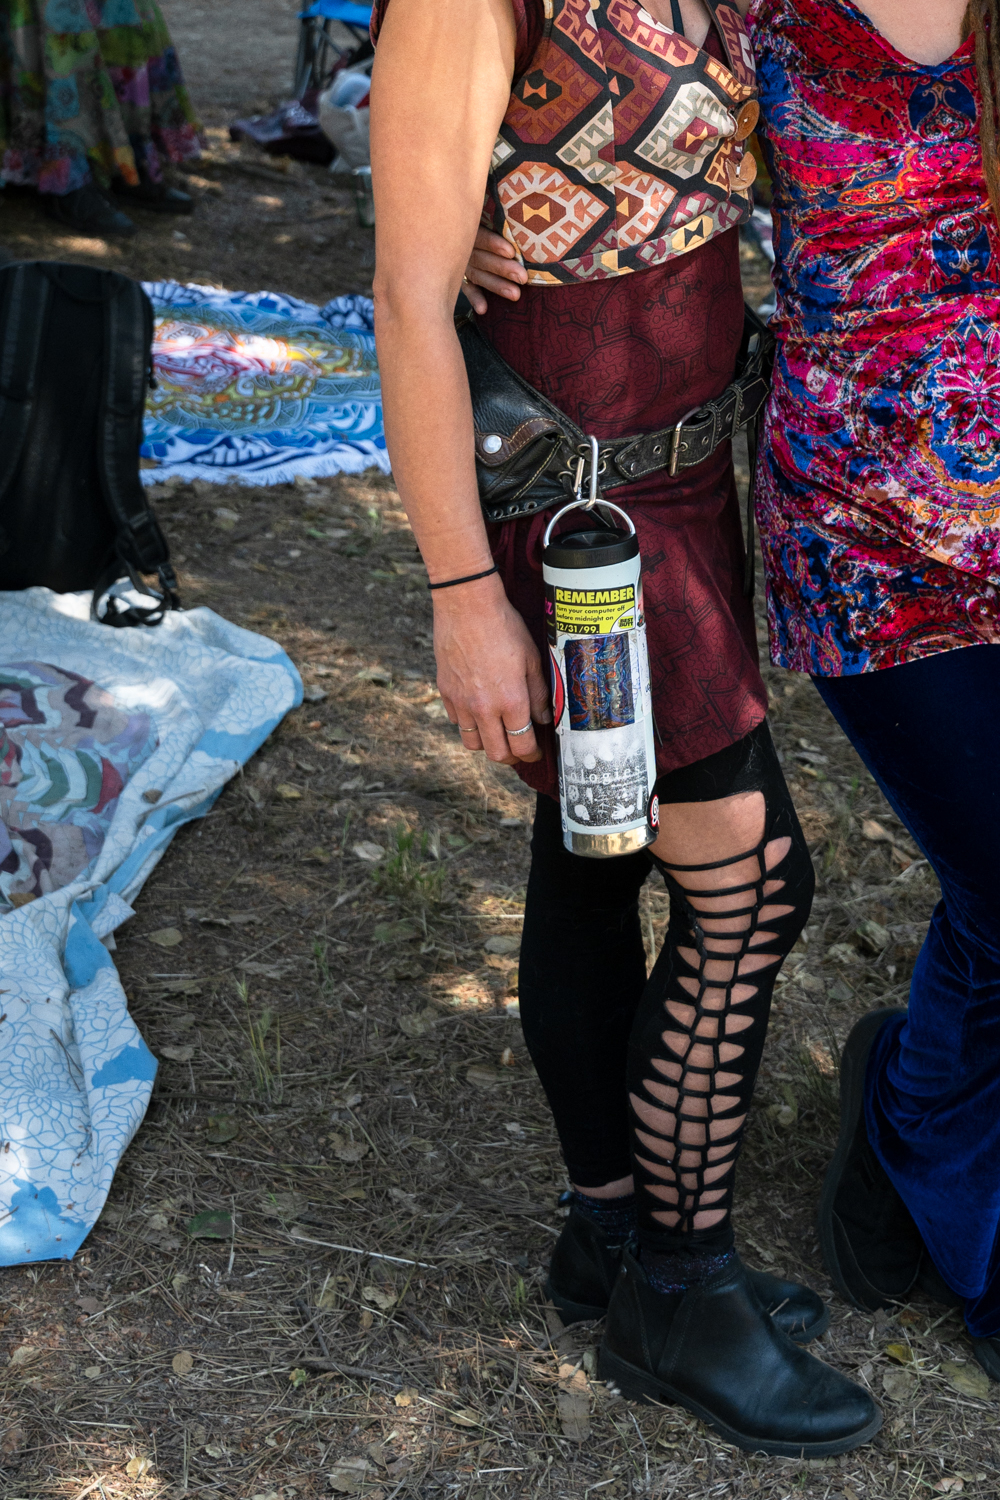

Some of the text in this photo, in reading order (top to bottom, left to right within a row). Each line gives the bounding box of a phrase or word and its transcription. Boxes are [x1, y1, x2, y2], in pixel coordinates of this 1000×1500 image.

[555, 587, 634, 604] REMEMBER
[584, 607, 616, 615] computer
[556, 613, 574, 621] before
[574, 615, 604, 623] midnight
[556, 621, 600, 633] 12/31/99.
